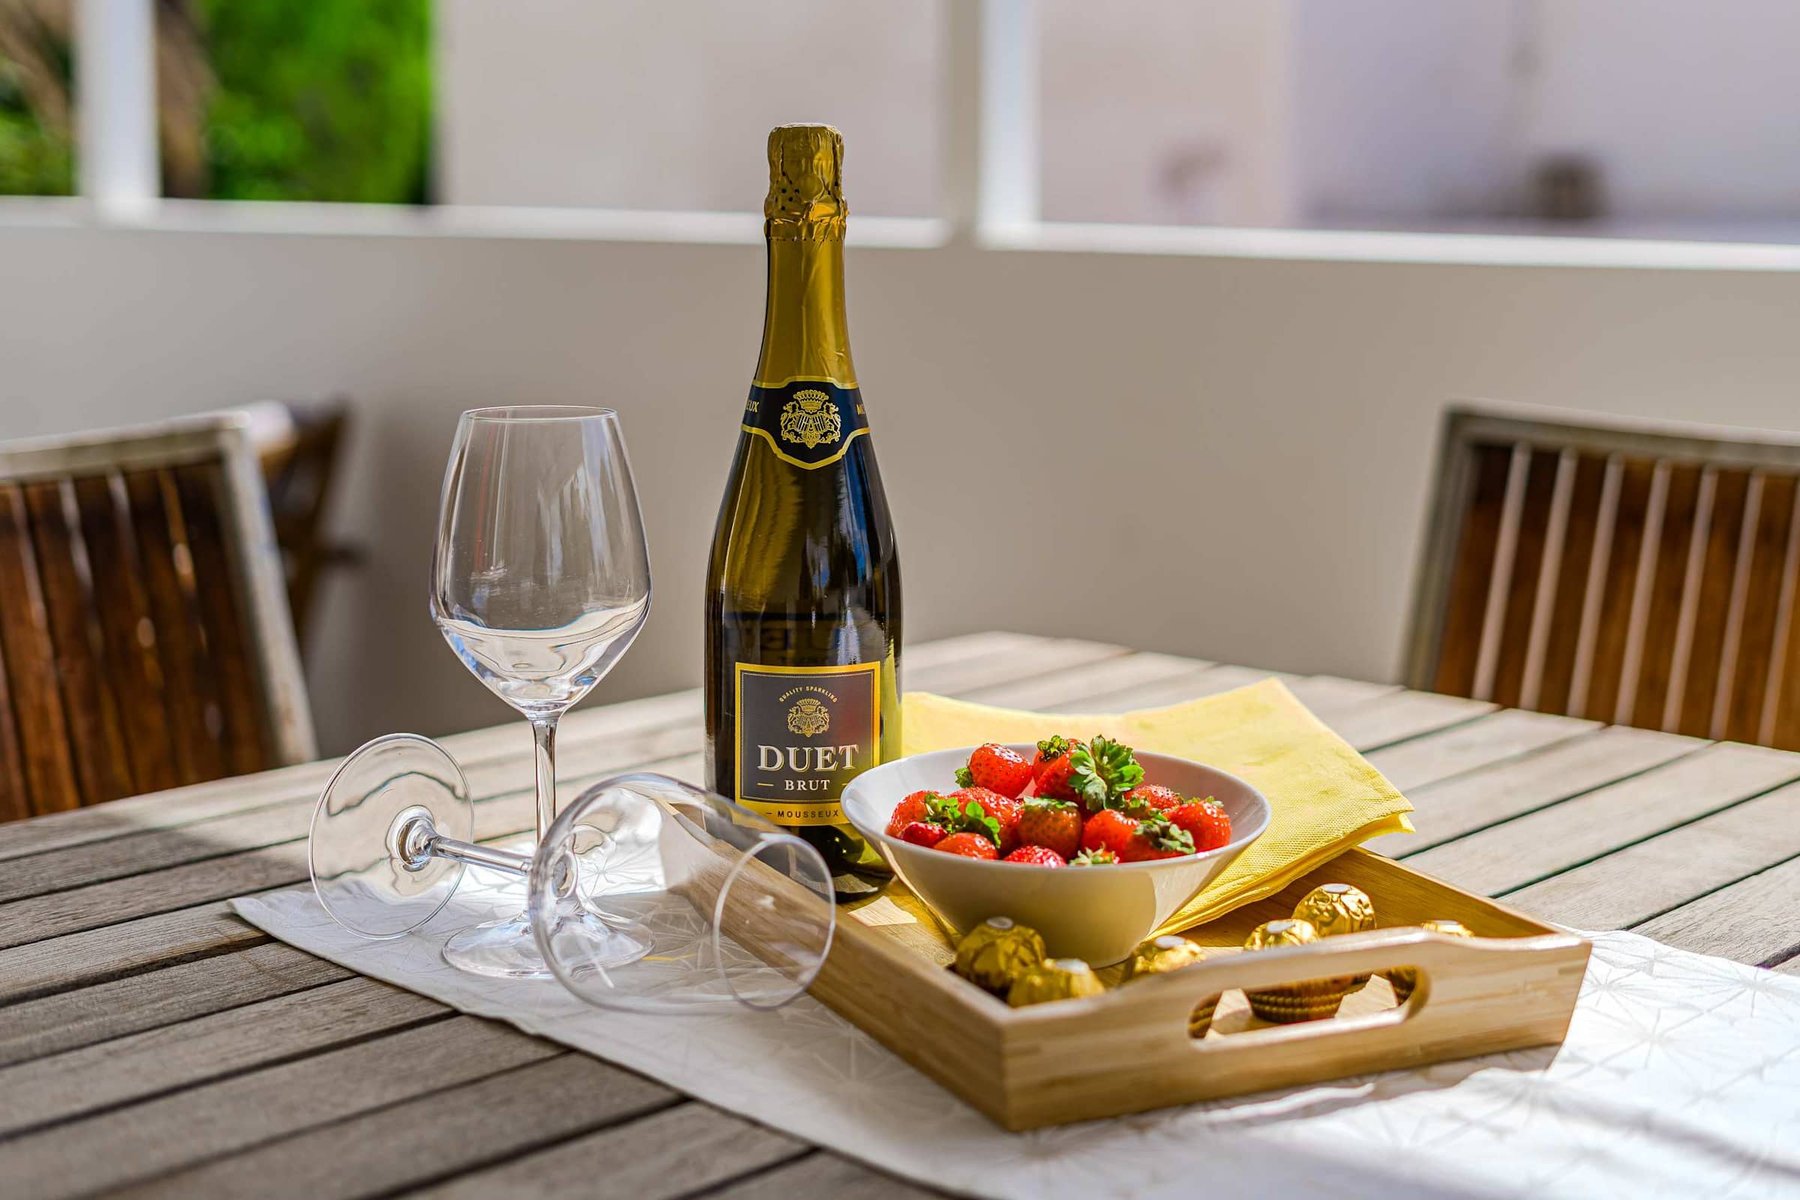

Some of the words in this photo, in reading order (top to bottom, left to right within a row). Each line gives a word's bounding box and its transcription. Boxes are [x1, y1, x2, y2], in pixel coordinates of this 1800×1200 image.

[779, 687, 802, 702] QUALITY
[805, 686, 838, 703] SPARKLING
[757, 744, 860, 773] DUET
[784, 779, 831, 791] BRUT
[777, 810, 839, 819] MOUSSEUX
